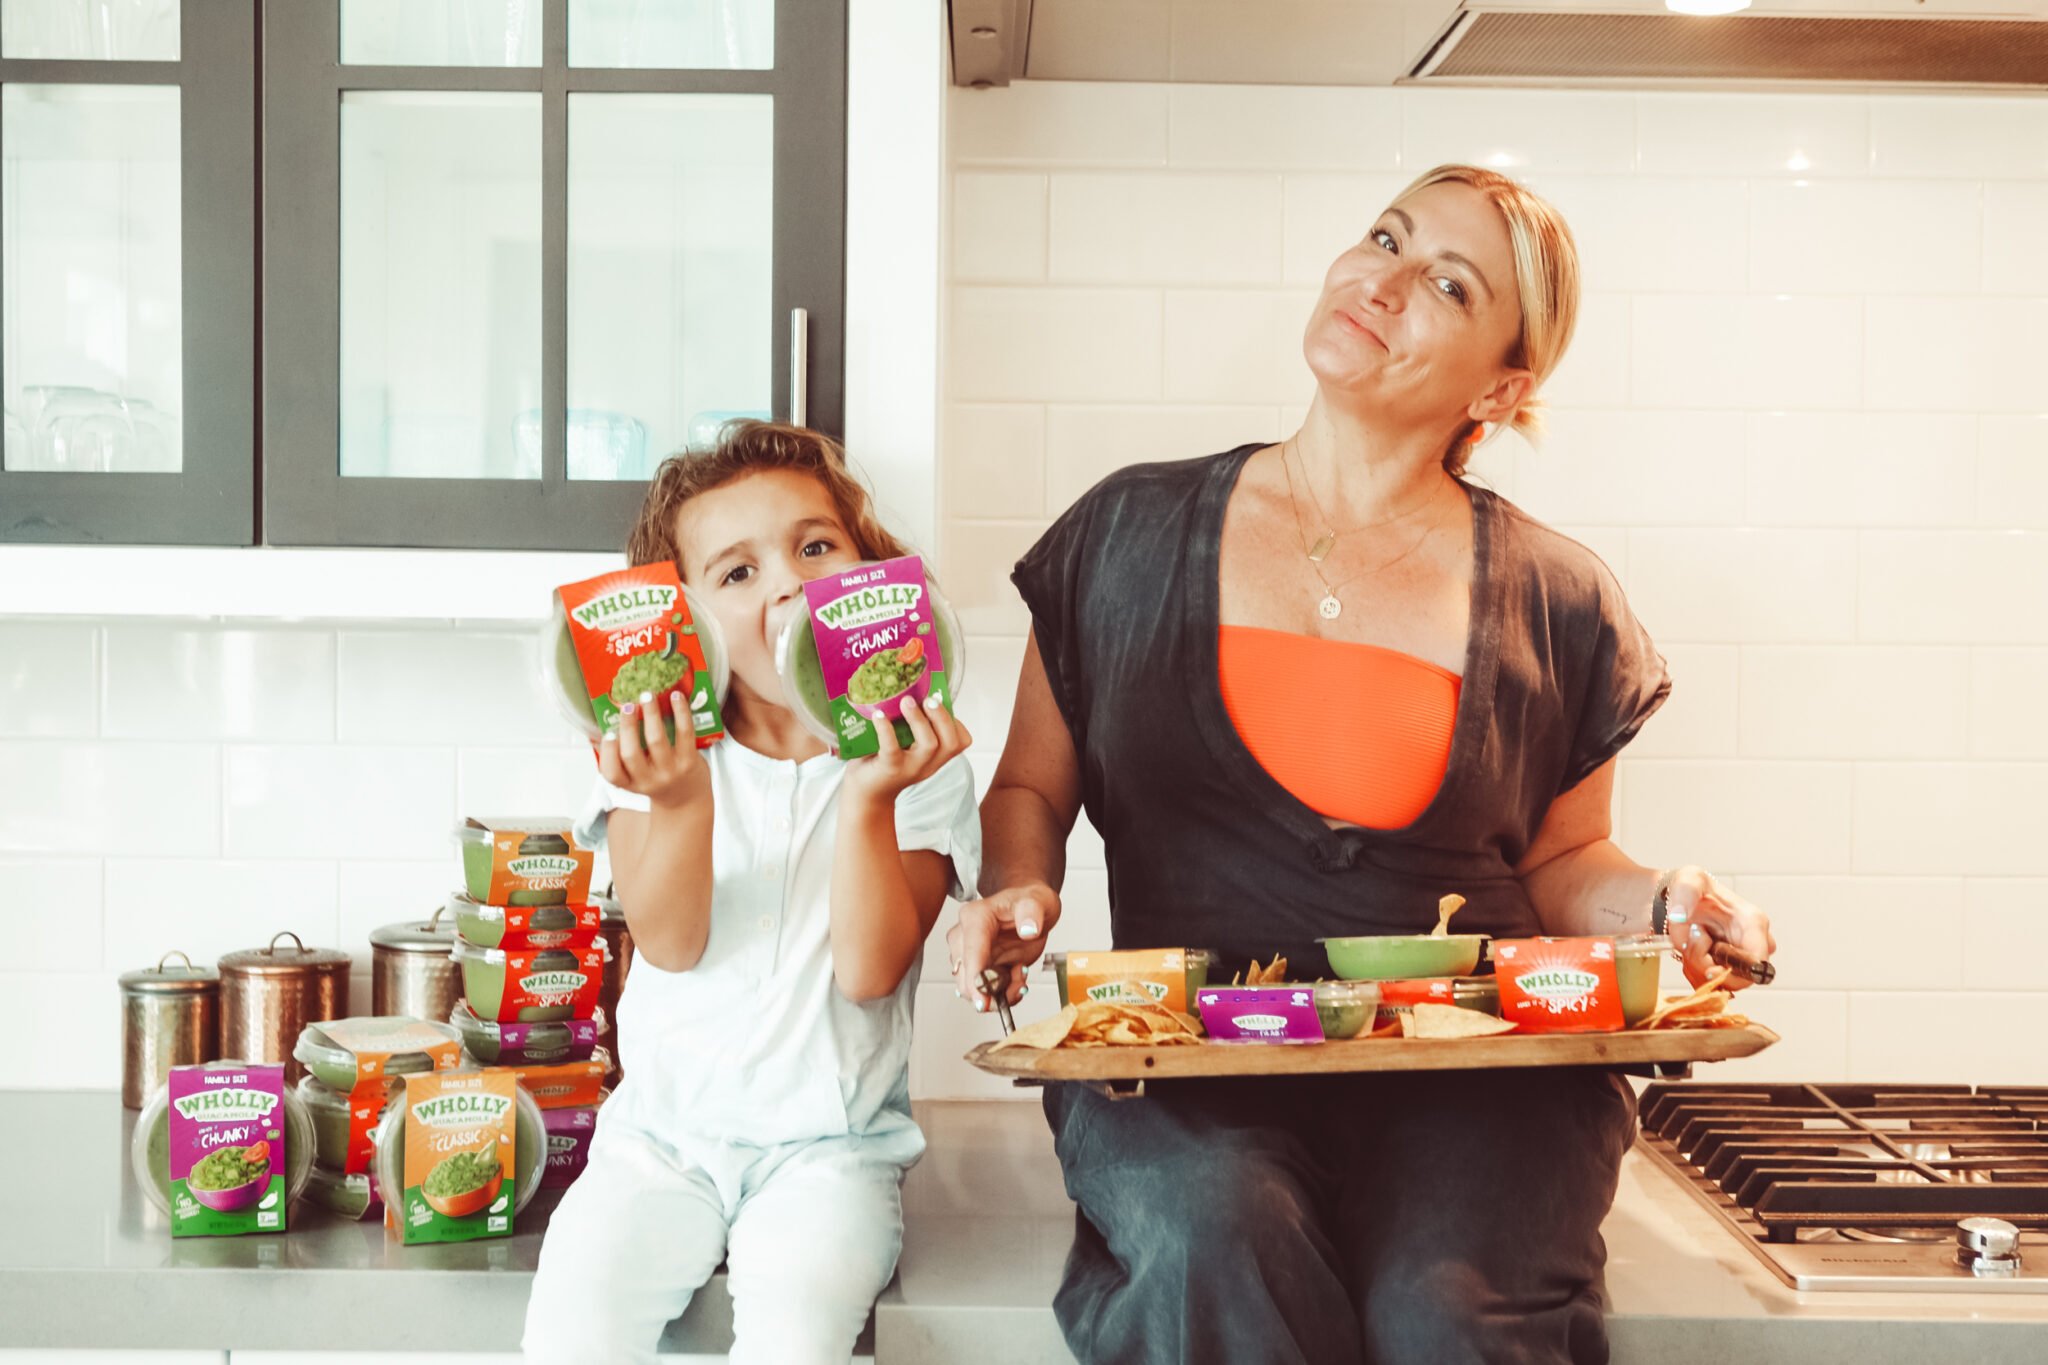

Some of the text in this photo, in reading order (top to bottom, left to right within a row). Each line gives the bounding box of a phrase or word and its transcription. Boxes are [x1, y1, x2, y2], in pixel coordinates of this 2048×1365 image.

[841, 569, 887, 588] FAMILY SIZE
[577, 589, 673, 623] WHOLLY
[821, 587, 918, 623] WHOLLY
[600, 609, 660, 628] GUACAMOLE
[841, 608, 903, 628] GUACAMOLE
[615, 625, 653, 657] SPICY
[851, 624, 899, 658] CHUNKY
[511, 858, 575, 872] WHOLLY
[528, 878, 569, 891] CLASSIC
[523, 974, 586, 989] WHOLLY
[1520, 972, 1596, 990] WHOLLY
[539, 991, 574, 1008] SPICY
[1090, 984, 1166, 1000] WHY
[1548, 995, 1589, 1015] SPICY
[204, 1074, 248, 1084] FAMILY SIZE
[179, 1091, 274, 1114] WHOLLY
[416, 1096, 508, 1120] WHOLLY
[196, 1111, 256, 1120] GUACAMOLE
[432, 1115, 489, 1126] GUACAMOLE
[201, 1125, 249, 1149] CHUNKY
[437, 1129, 482, 1152] CLASSIC
